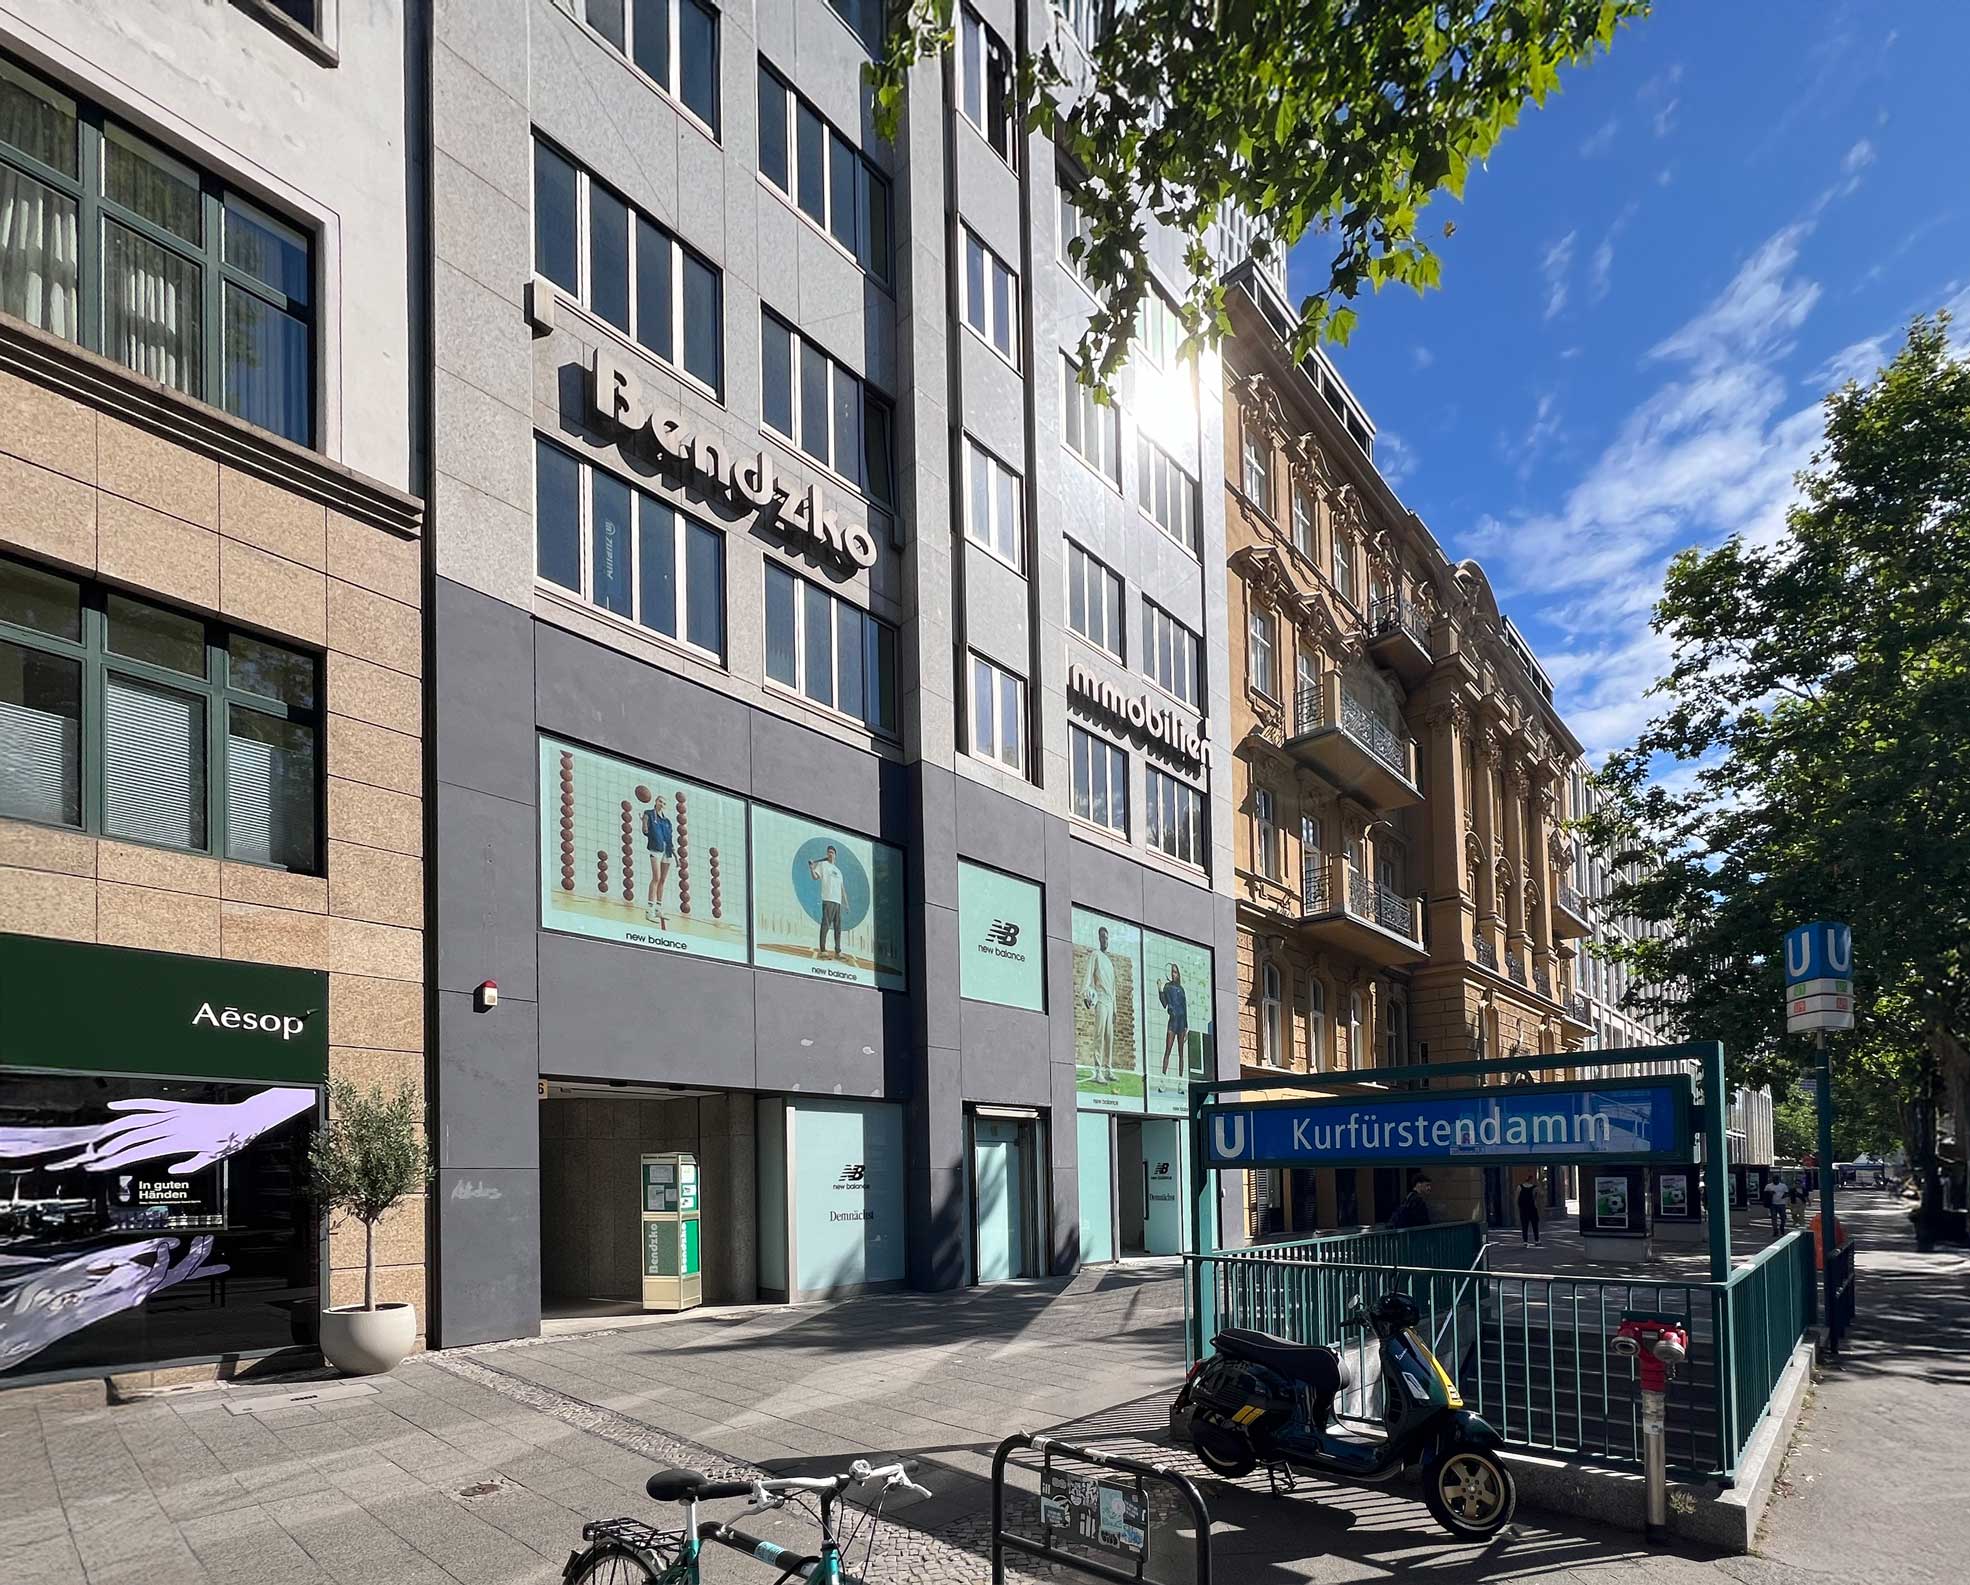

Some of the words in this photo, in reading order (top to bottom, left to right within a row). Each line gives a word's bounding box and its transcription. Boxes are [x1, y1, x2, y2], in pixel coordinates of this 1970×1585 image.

[593, 346, 877, 568] Bendzko
[625, 932, 647, 943] new
[648, 935, 687, 950] balance
[978, 944, 994, 955] new
[995, 947, 1026, 962] balance
[828, 969, 857, 981] balance
[1215, 1114, 1246, 1159] U
[1293, 1105, 1611, 1152] Kurfürstendamm
[139, 1181, 151, 1190] In
[154, 1181, 190, 1192] guten
[139, 1190, 188, 1200] Händen
[648, 1223, 659, 1274] Bendzko
